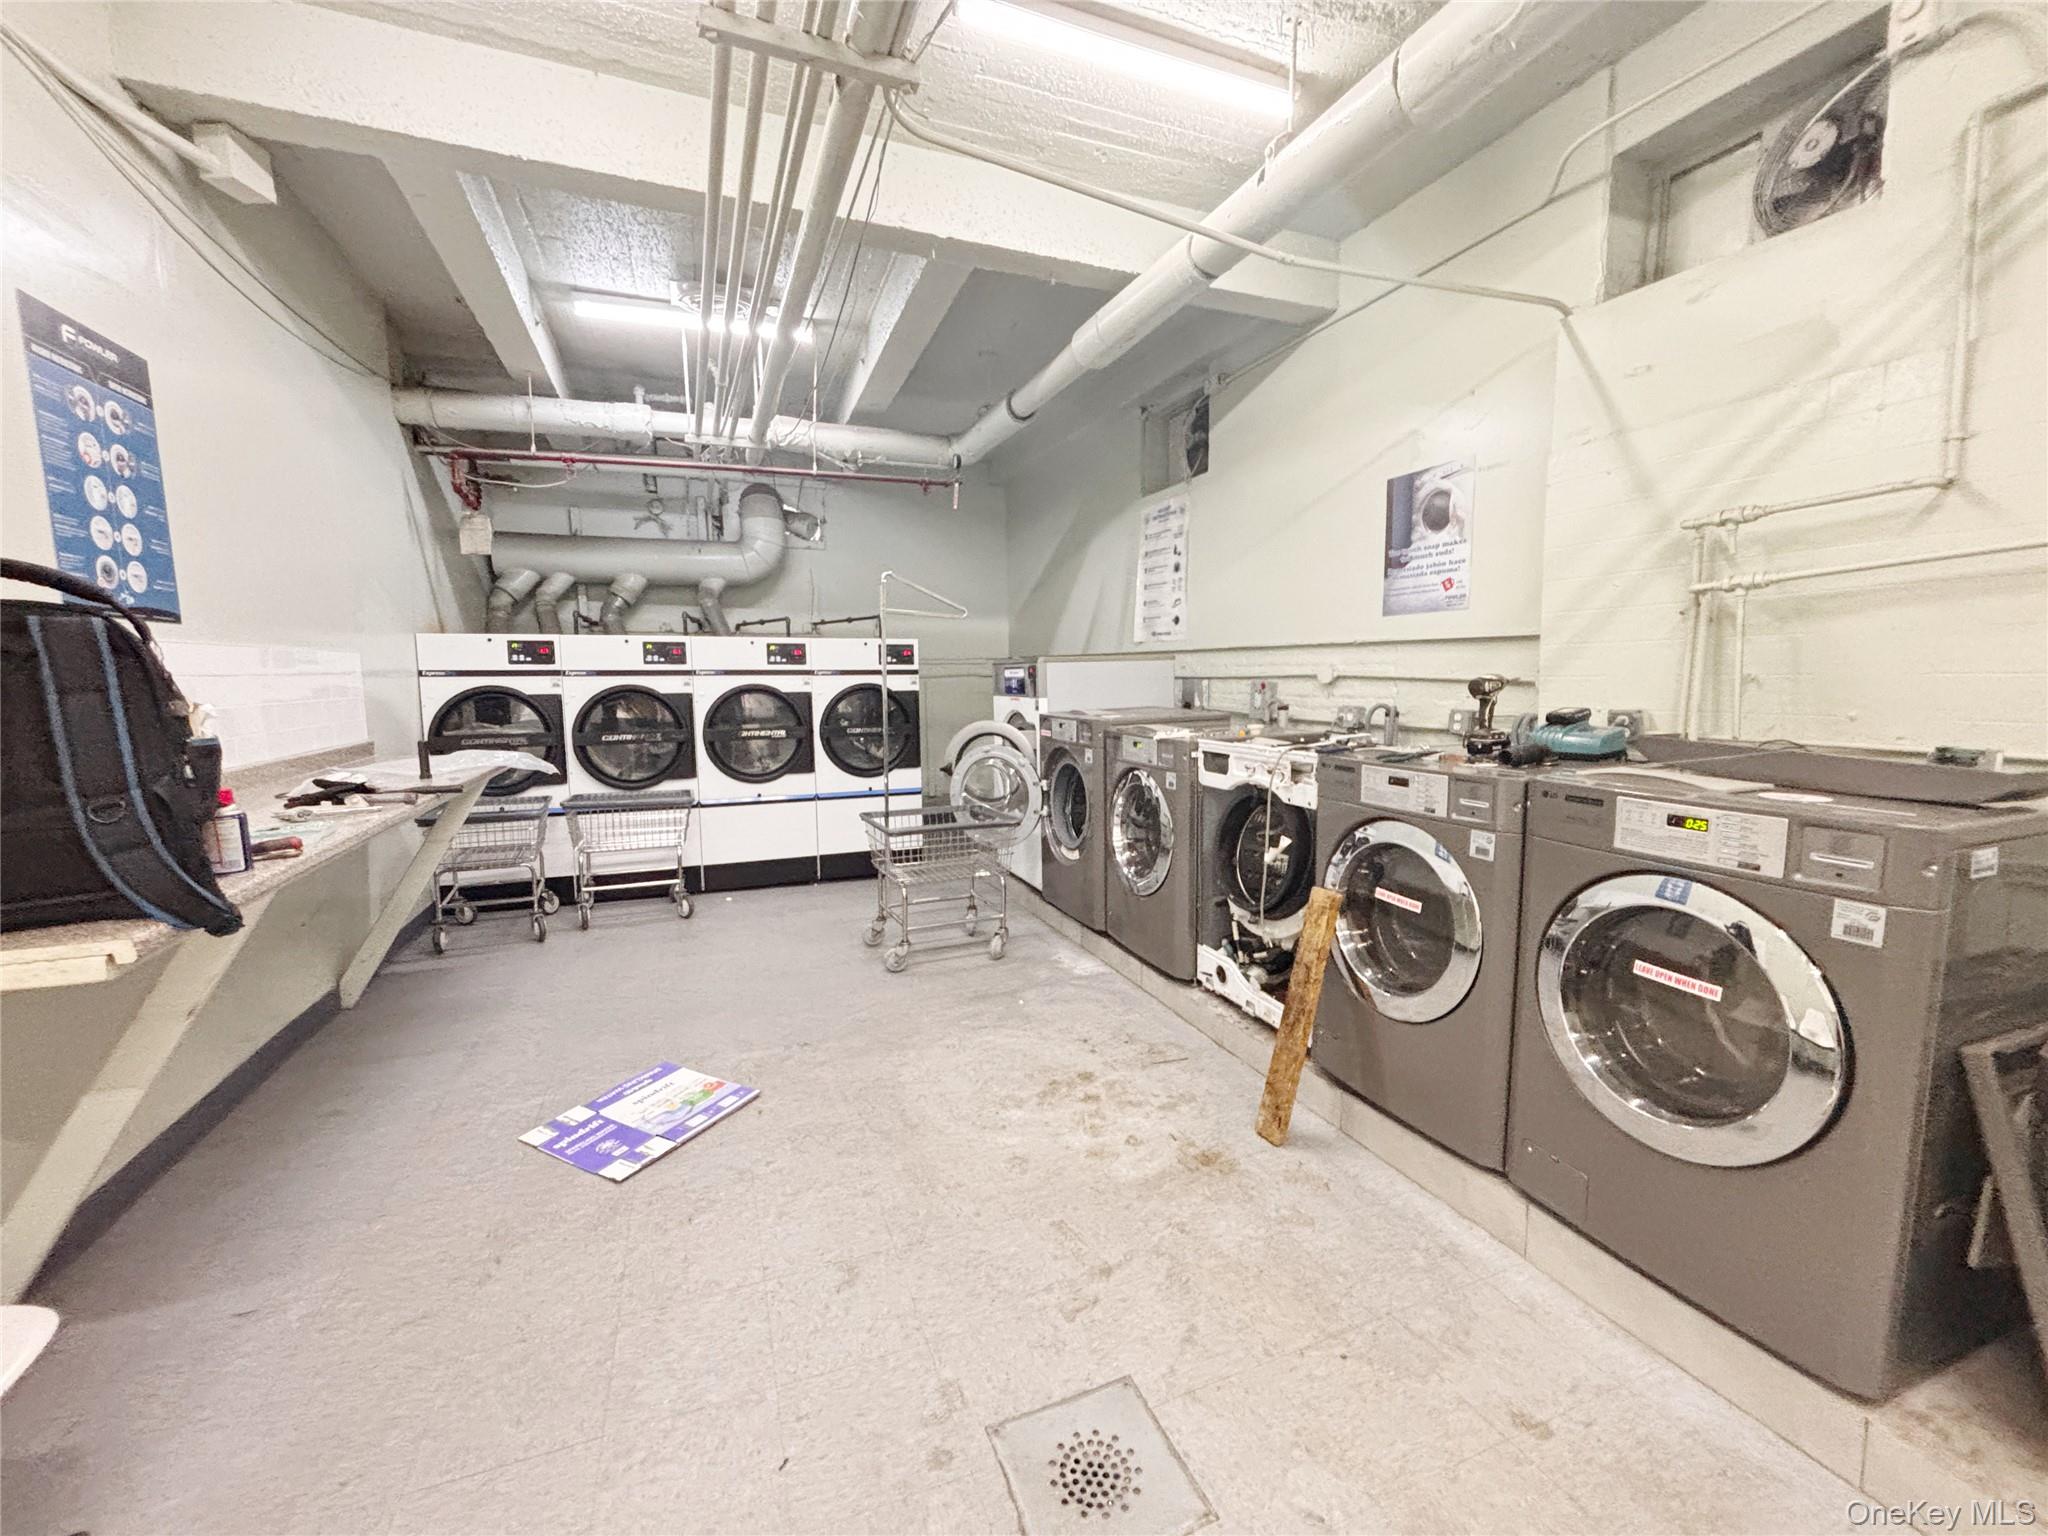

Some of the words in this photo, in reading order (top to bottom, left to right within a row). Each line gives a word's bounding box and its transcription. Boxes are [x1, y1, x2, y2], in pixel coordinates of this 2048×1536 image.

[1635, 962, 1654, 976] LEAVE
[1654, 969, 1673, 983] OPEN
[1674, 974, 1697, 990] WHEN
[1697, 983, 1720, 998] DONE
